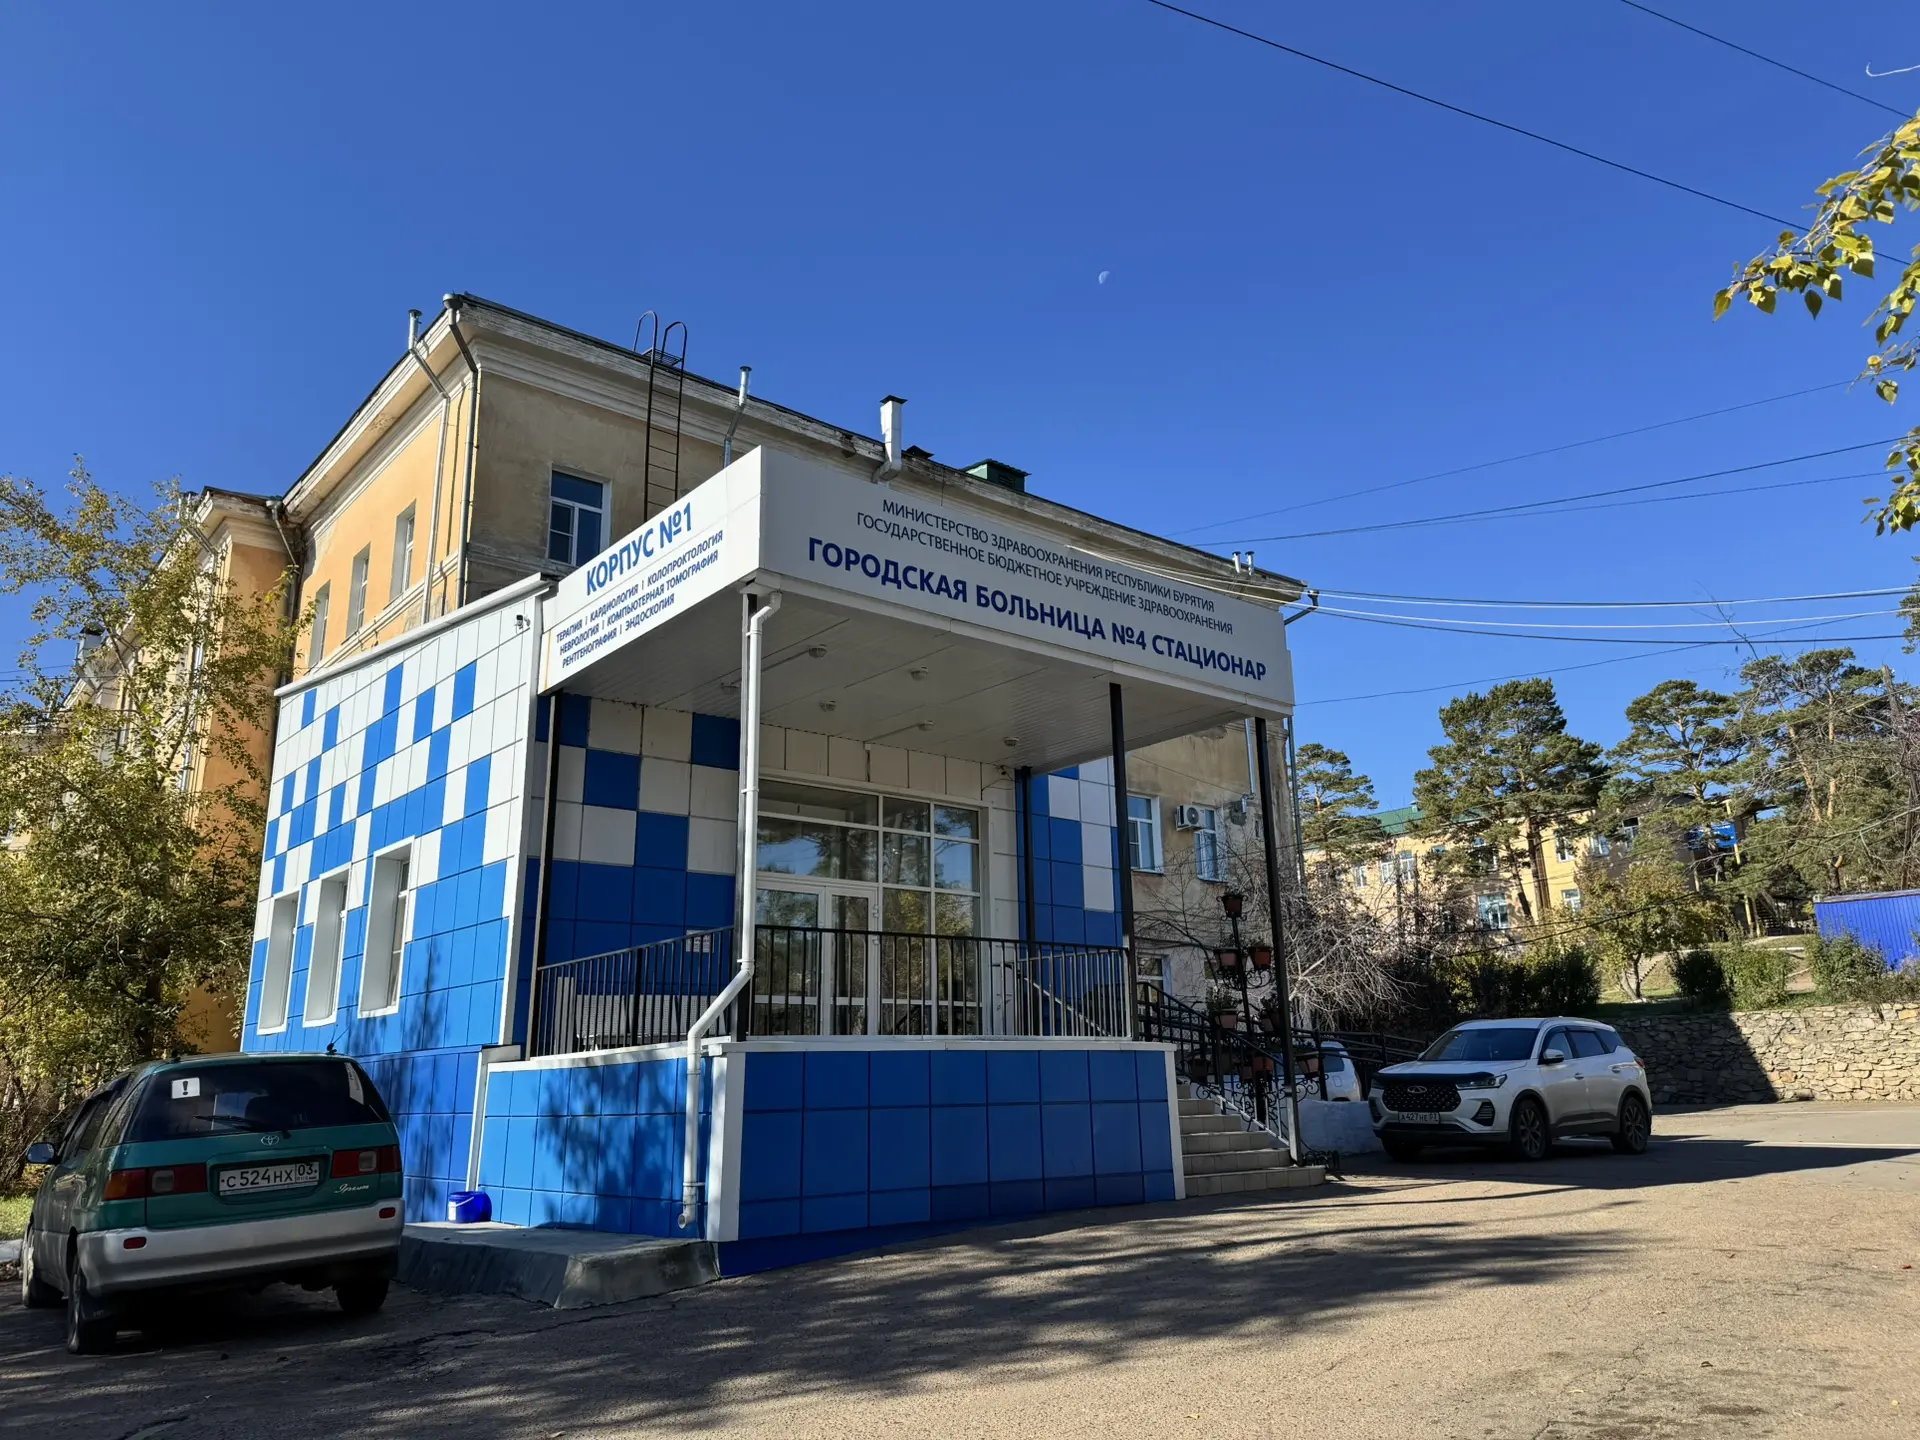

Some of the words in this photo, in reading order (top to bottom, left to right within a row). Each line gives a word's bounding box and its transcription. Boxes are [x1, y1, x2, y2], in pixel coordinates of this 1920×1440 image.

[556, 619, 583, 643] ТЕРАПИЯ
[590, 583, 639, 623] КАРДИОЛОГИЯ
[647, 530, 723, 587] КОЛОПРОКТОЛОГИЯ
[560, 622, 600, 656] НЕВРОЛОГИЯ
[606, 583, 665, 627] КОМПЬЮТЕРНАЯ
[666, 549, 719, 591] ТОМОГРАФИЯ
[586, 527, 654, 596] КОРПУС
[659, 502, 692, 549] №1
[857, 512, 985, 563] ГОСУДАРСТВЕННОЕ
[987, 552, 1062, 586] БЮДЖЕТНОЕ
[1064, 575, 1136, 607] УЧРЕЖДЕНИЕ
[1138, 596, 1233, 635] ЗДРАВООХРАНЕНИЯ
[882, 499, 988, 543] МИНИСТЕРСТВО
[991, 533, 1103, 579] ЗДРАВООХРАНЕНИЯ
[1105, 568, 1171, 600] РЕСПУБЛИКИ
[1173, 589, 1214, 612] БУРЯТИЯ
[562, 627, 617, 668] РЕНТГЕНОГРАФИЯ
[625, 593, 675, 631] ЭНДОСКОПИЯ
[808, 537, 968, 603] ГОРОДСКАЯ
[976, 584, 1106, 640] БОЛЬНИЦА
[1112, 622, 1147, 650] №4
[1152, 635, 1267, 681] СТАЦИОНАР
[298, 1163, 314, 1176] 03
